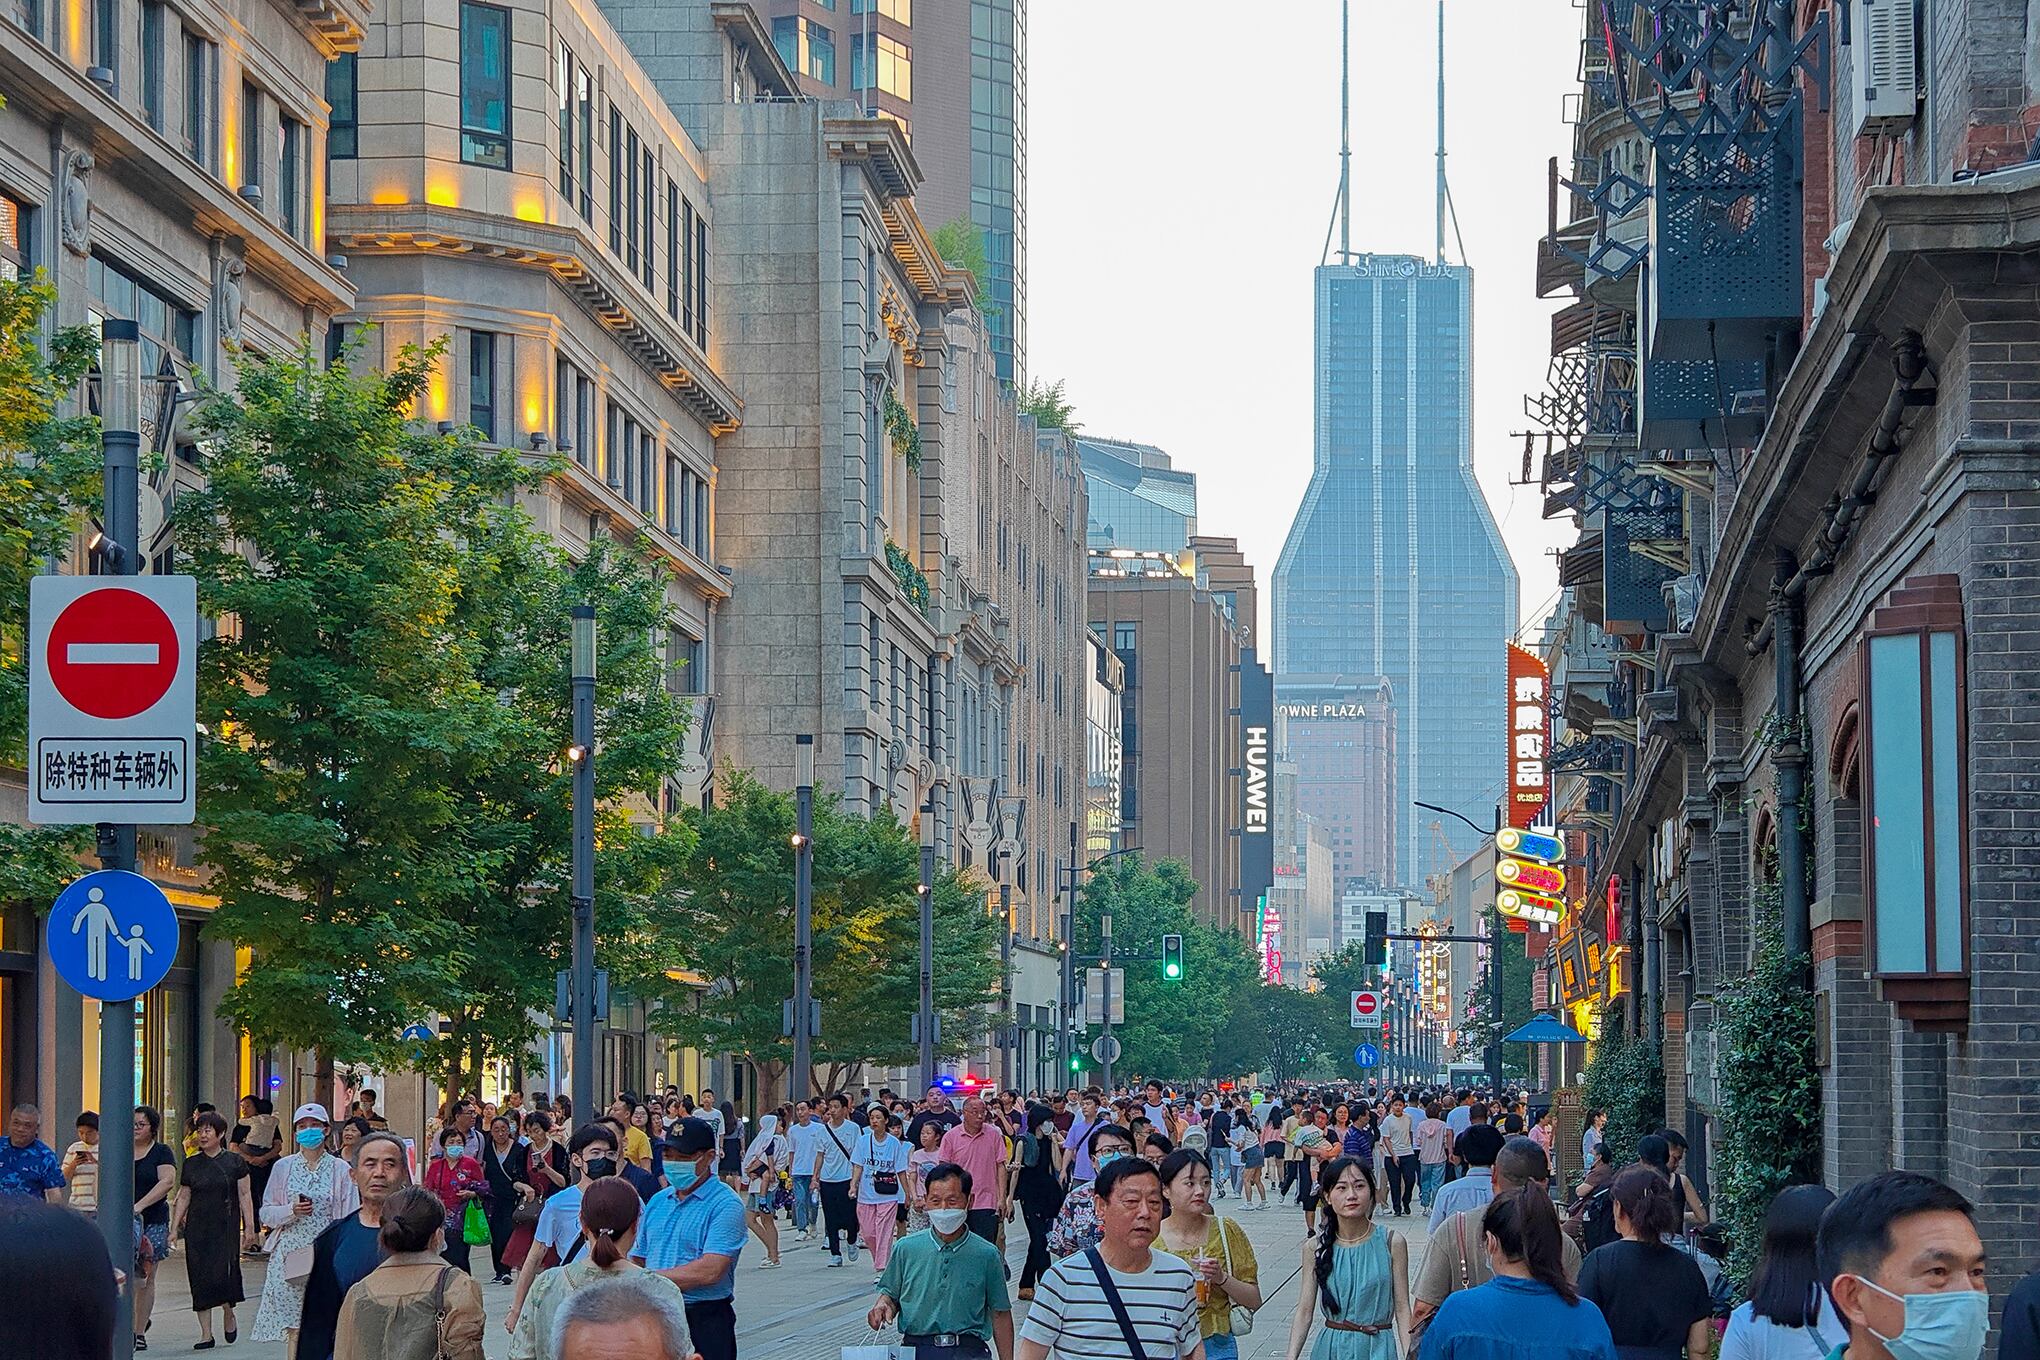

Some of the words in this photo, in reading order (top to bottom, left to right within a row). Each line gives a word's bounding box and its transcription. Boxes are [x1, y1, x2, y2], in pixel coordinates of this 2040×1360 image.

[1279, 705, 1318, 717] OWNE
[1323, 705, 1366, 717] PLAZA
[45, 750, 179, 790] 除特种车辆外
[1246, 727, 1267, 832] HUAWEI
